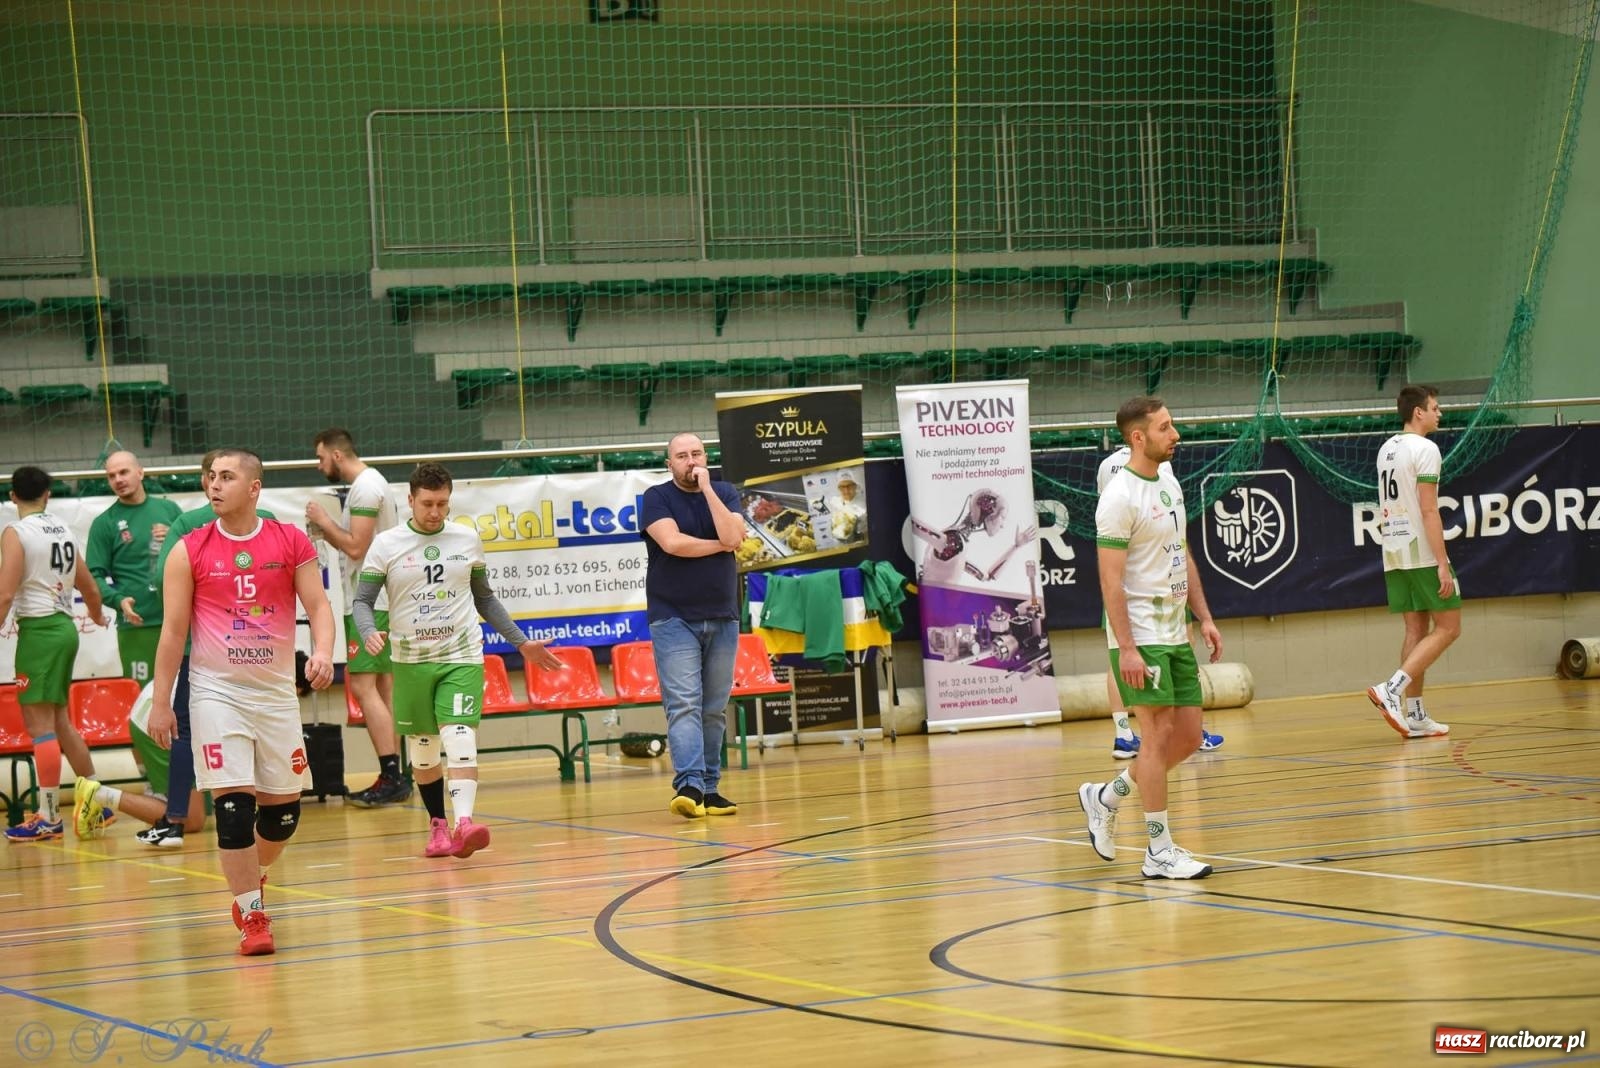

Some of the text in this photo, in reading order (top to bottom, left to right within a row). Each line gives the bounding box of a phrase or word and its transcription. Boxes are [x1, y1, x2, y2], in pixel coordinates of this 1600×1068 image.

[916, 397, 1015, 423] PIVEXIN
[755, 420, 828, 439] SZYPUŁA
[919, 420, 1015, 438] TECHNOLOGY
[915, 450, 931, 459] Nie
[932, 448, 976, 458] zwalniamy
[931, 466, 1025, 481] nowymi technologiami
[944, 459, 988, 470] podążamy
[1381, 468, 1399, 501] 16
[1352, 474, 1600, 546] RCIBÓR
[51, 540, 75, 575] 49
[424, 563, 444, 585] 12
[503, 566, 521, 579] 88,
[527, 564, 550, 577] 502
[554, 562, 578, 575] 632
[618, 557, 641, 570] 606
[233, 573, 257, 599] 15
[535, 580, 549, 596] ul.
[566, 582, 591, 594] von
[595, 576, 646, 592] Eichend
[1171, 580, 1187, 592] PIVE
[416, 625, 454, 637] PIVEXIN
[228, 647, 274, 658] PIVEXIN
[131, 661, 149, 680] 19
[453, 692, 475, 716] 12
[940, 695, 1018, 709] www.pivexin-tech.pl
[202, 743, 223, 770] 15
